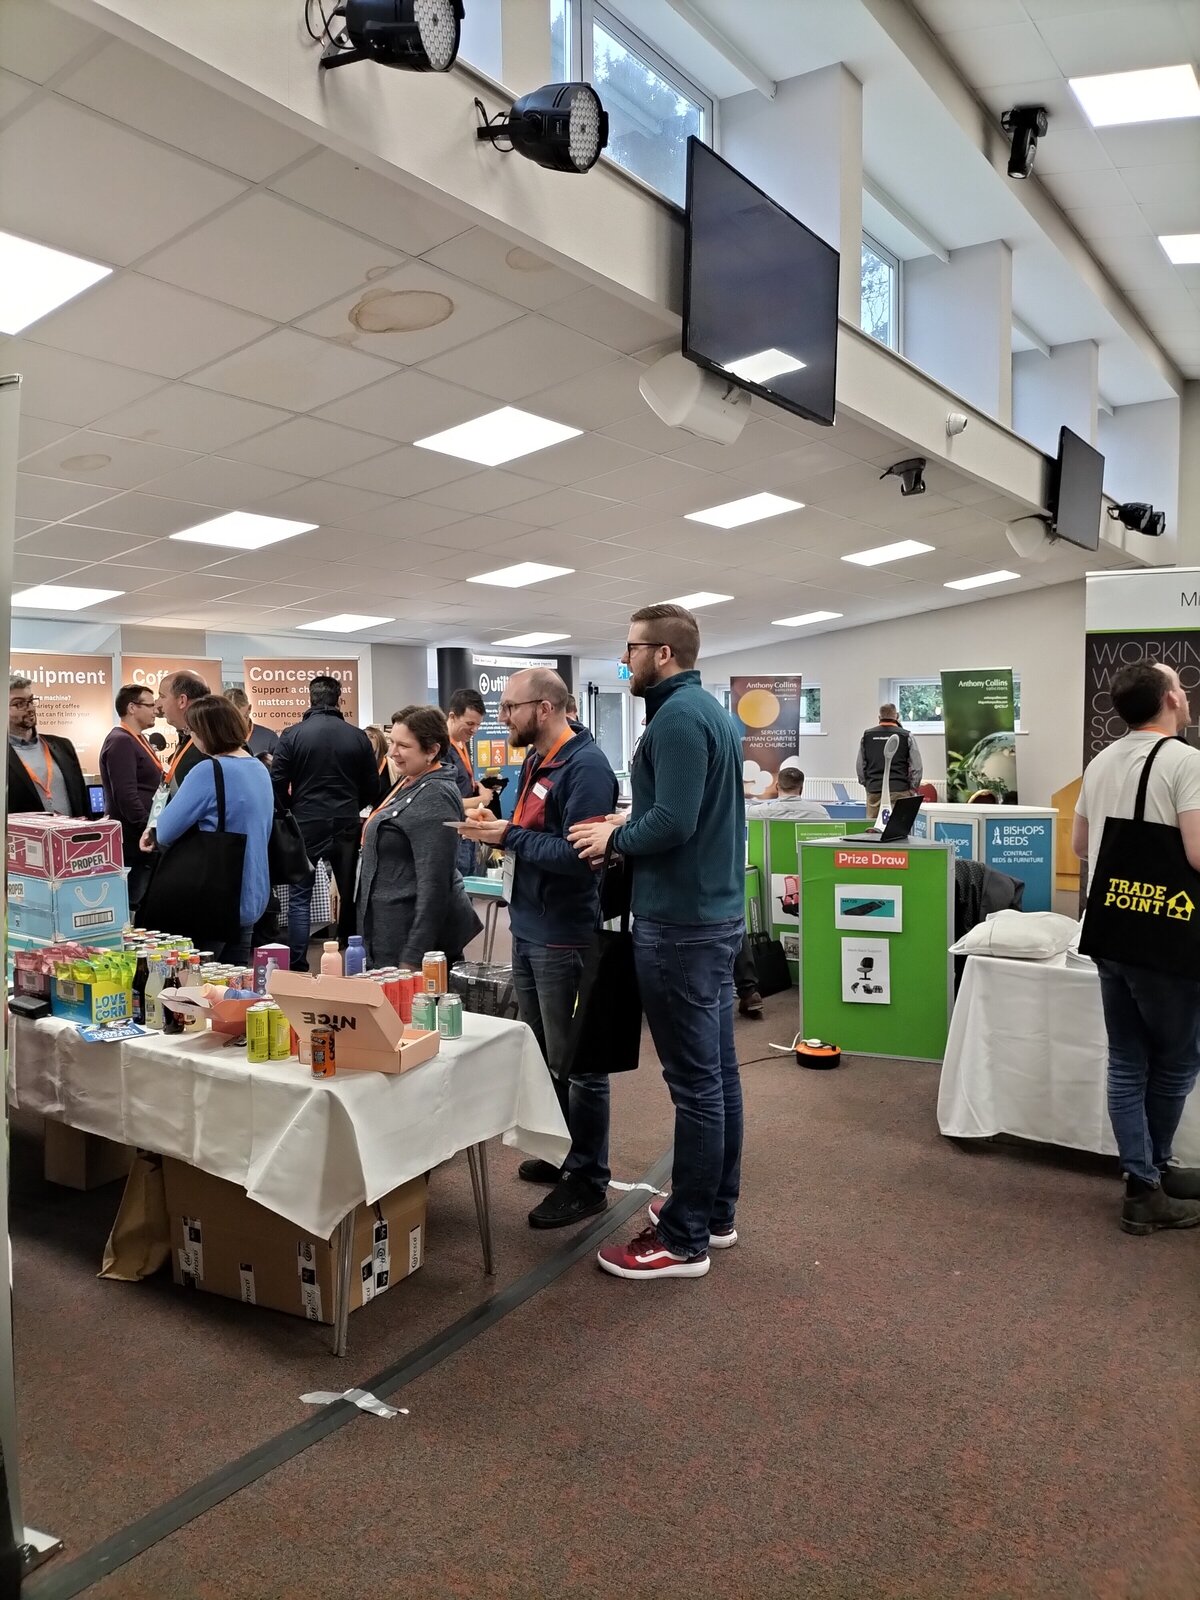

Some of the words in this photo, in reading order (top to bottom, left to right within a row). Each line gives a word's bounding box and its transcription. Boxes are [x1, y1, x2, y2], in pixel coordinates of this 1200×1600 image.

[1093, 641, 1200, 664] WORKIN
[746, 681, 773, 690] Anthony
[774, 681, 797, 689] Collins
[958, 679, 985, 688] Anthony
[985, 678, 1008, 687] Collins
[252, 685, 289, 695] Support
[258, 698, 294, 706] matters
[296, 698, 306, 706] to
[1003, 825, 1045, 836] BISHOPS
[1003, 836, 1029, 846] BEDS
[71, 853, 104, 871] PROPER
[838, 852, 869, 864] Prize
[871, 853, 906, 865] Draw
[8, 883, 24, 896] ROPER
[1109, 878, 1167, 900] TRADE
[1104, 892, 1165, 915] POINT
[95, 992, 126, 1009] LOVE
[301, 1011, 357, 1030] NICE
